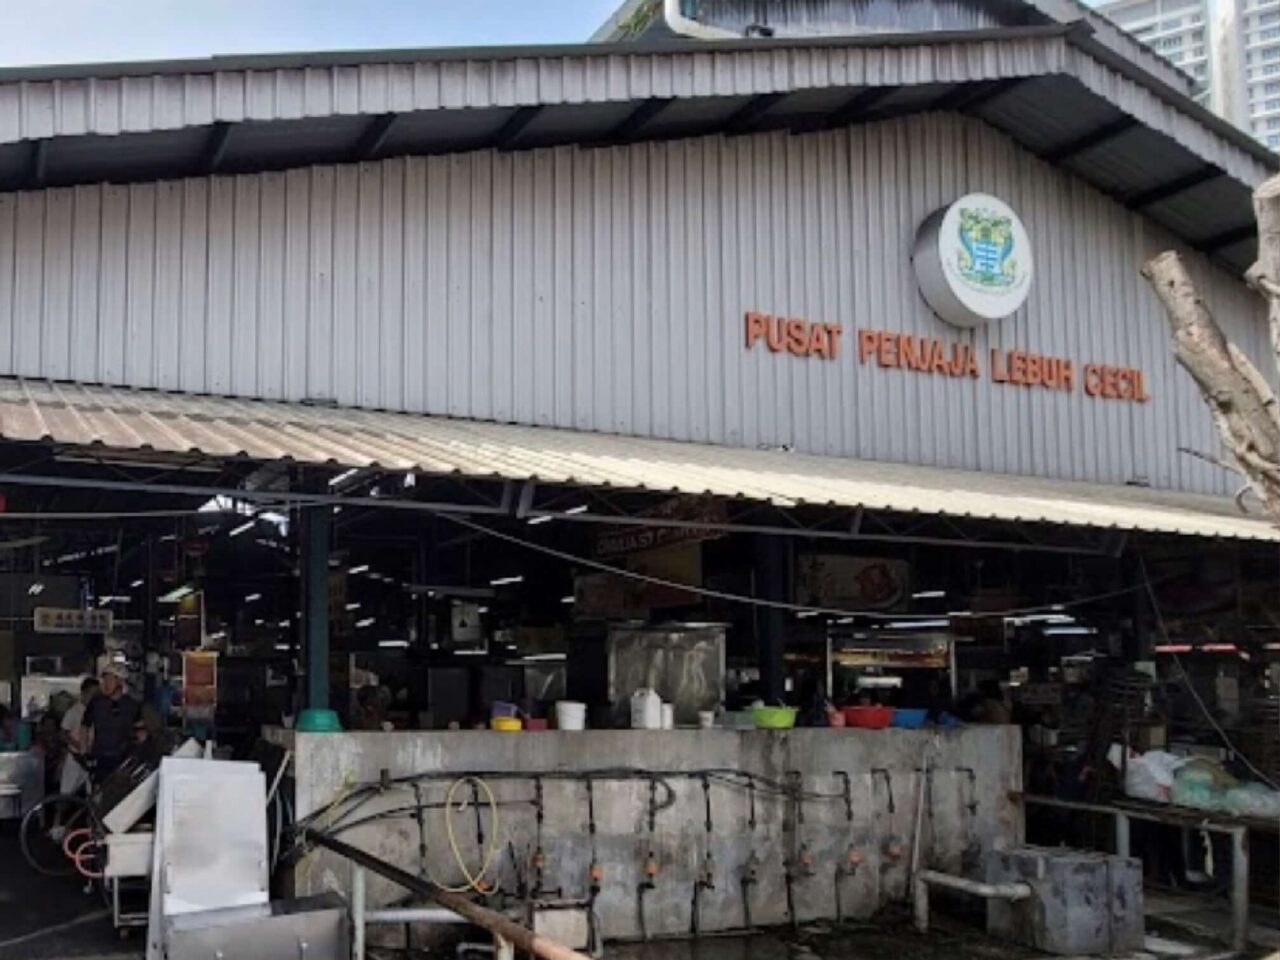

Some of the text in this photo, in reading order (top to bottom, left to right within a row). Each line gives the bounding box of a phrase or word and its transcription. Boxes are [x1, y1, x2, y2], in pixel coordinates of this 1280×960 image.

[745, 311, 1150, 402] PUSAT PENJAJA LEBUH CECIL
